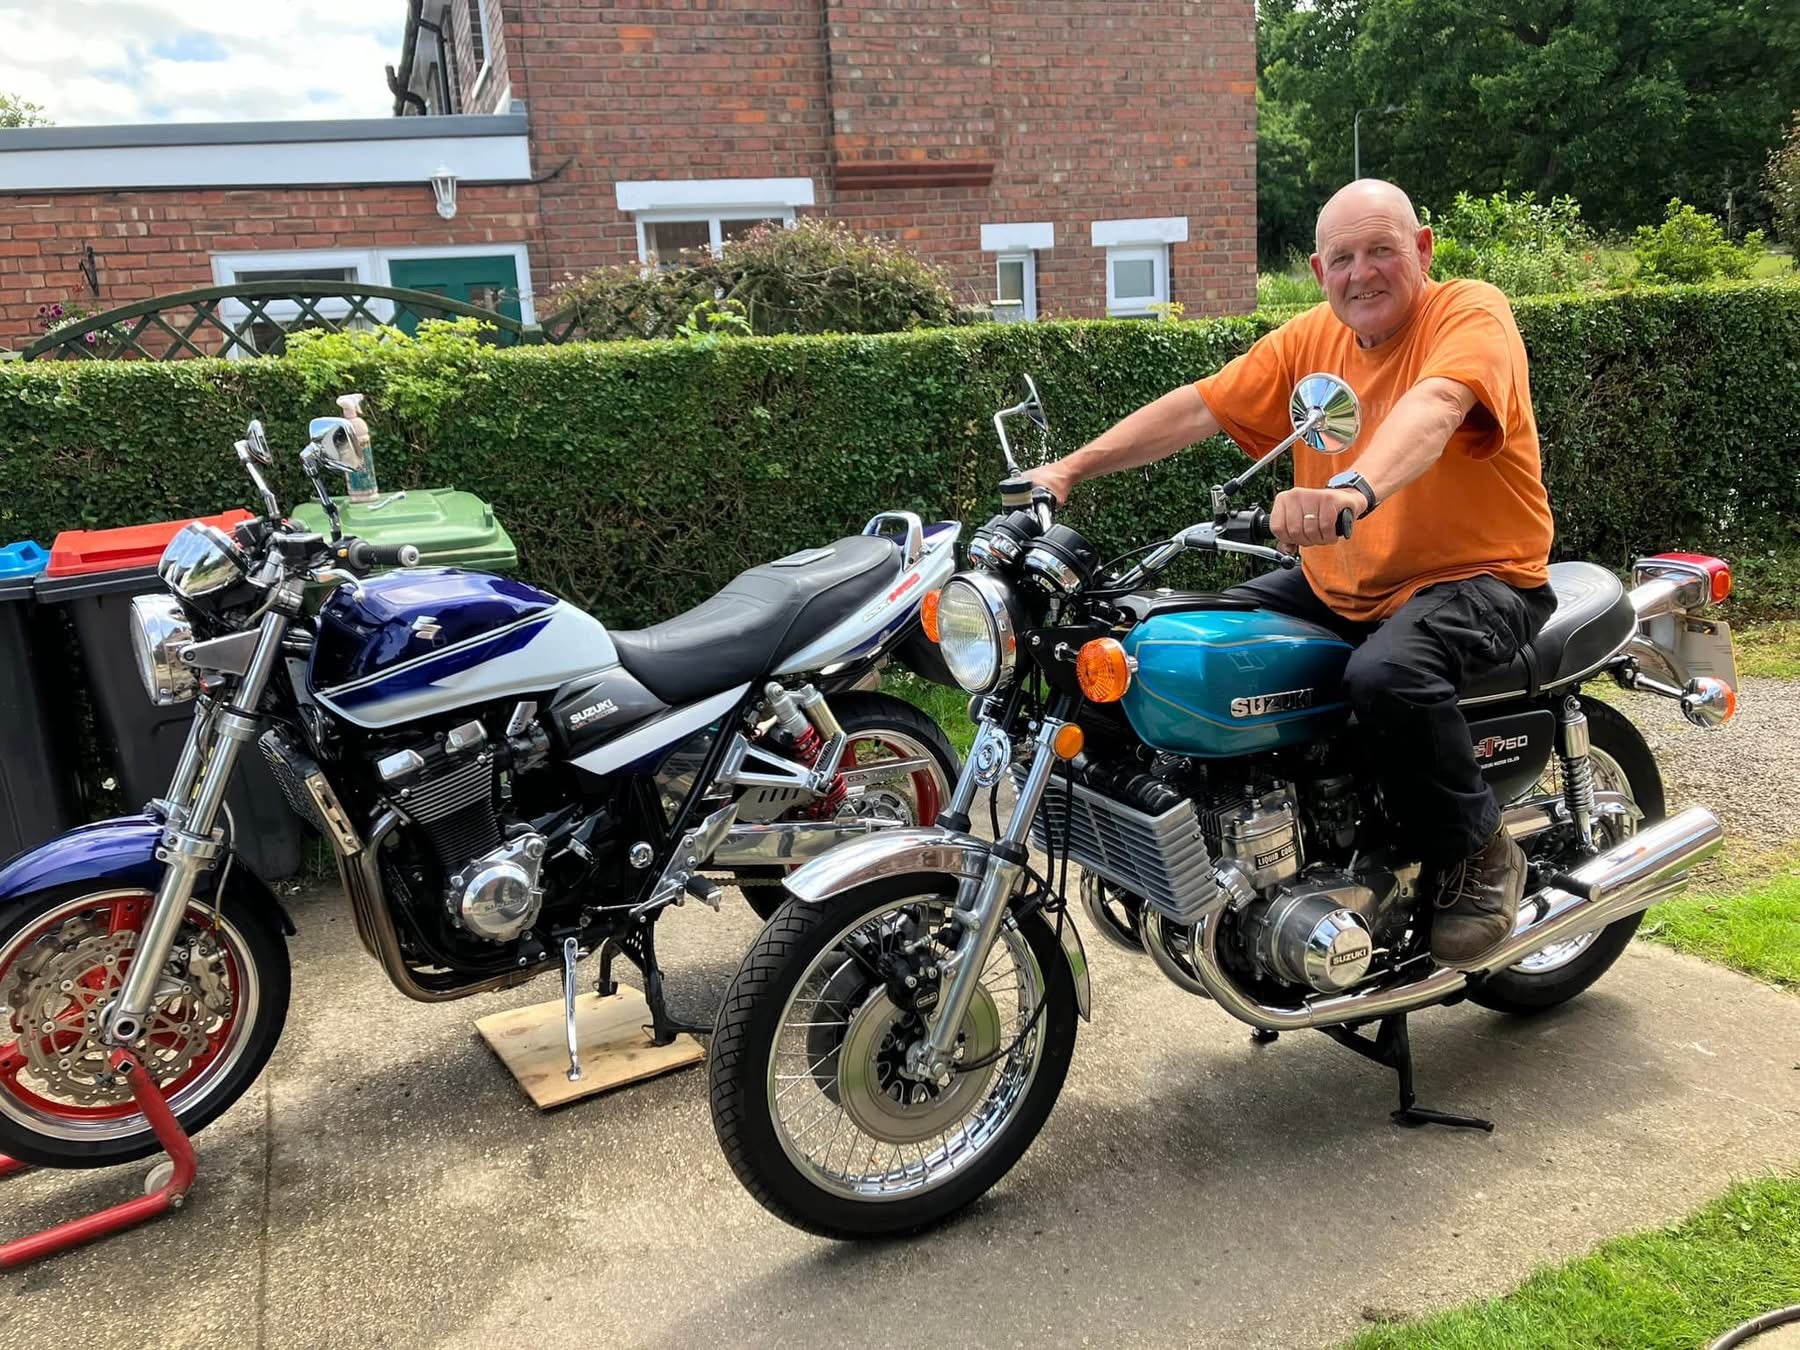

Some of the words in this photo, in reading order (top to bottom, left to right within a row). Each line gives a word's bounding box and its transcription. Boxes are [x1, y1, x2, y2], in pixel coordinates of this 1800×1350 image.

[1231, 688, 1314, 717] SUZUKI
[570, 699, 613, 724] SUZUKI
[848, 774, 869, 783] GSX
[1257, 852, 1279, 866] LIQUID
[1332, 949, 1367, 965] SUZUKI
